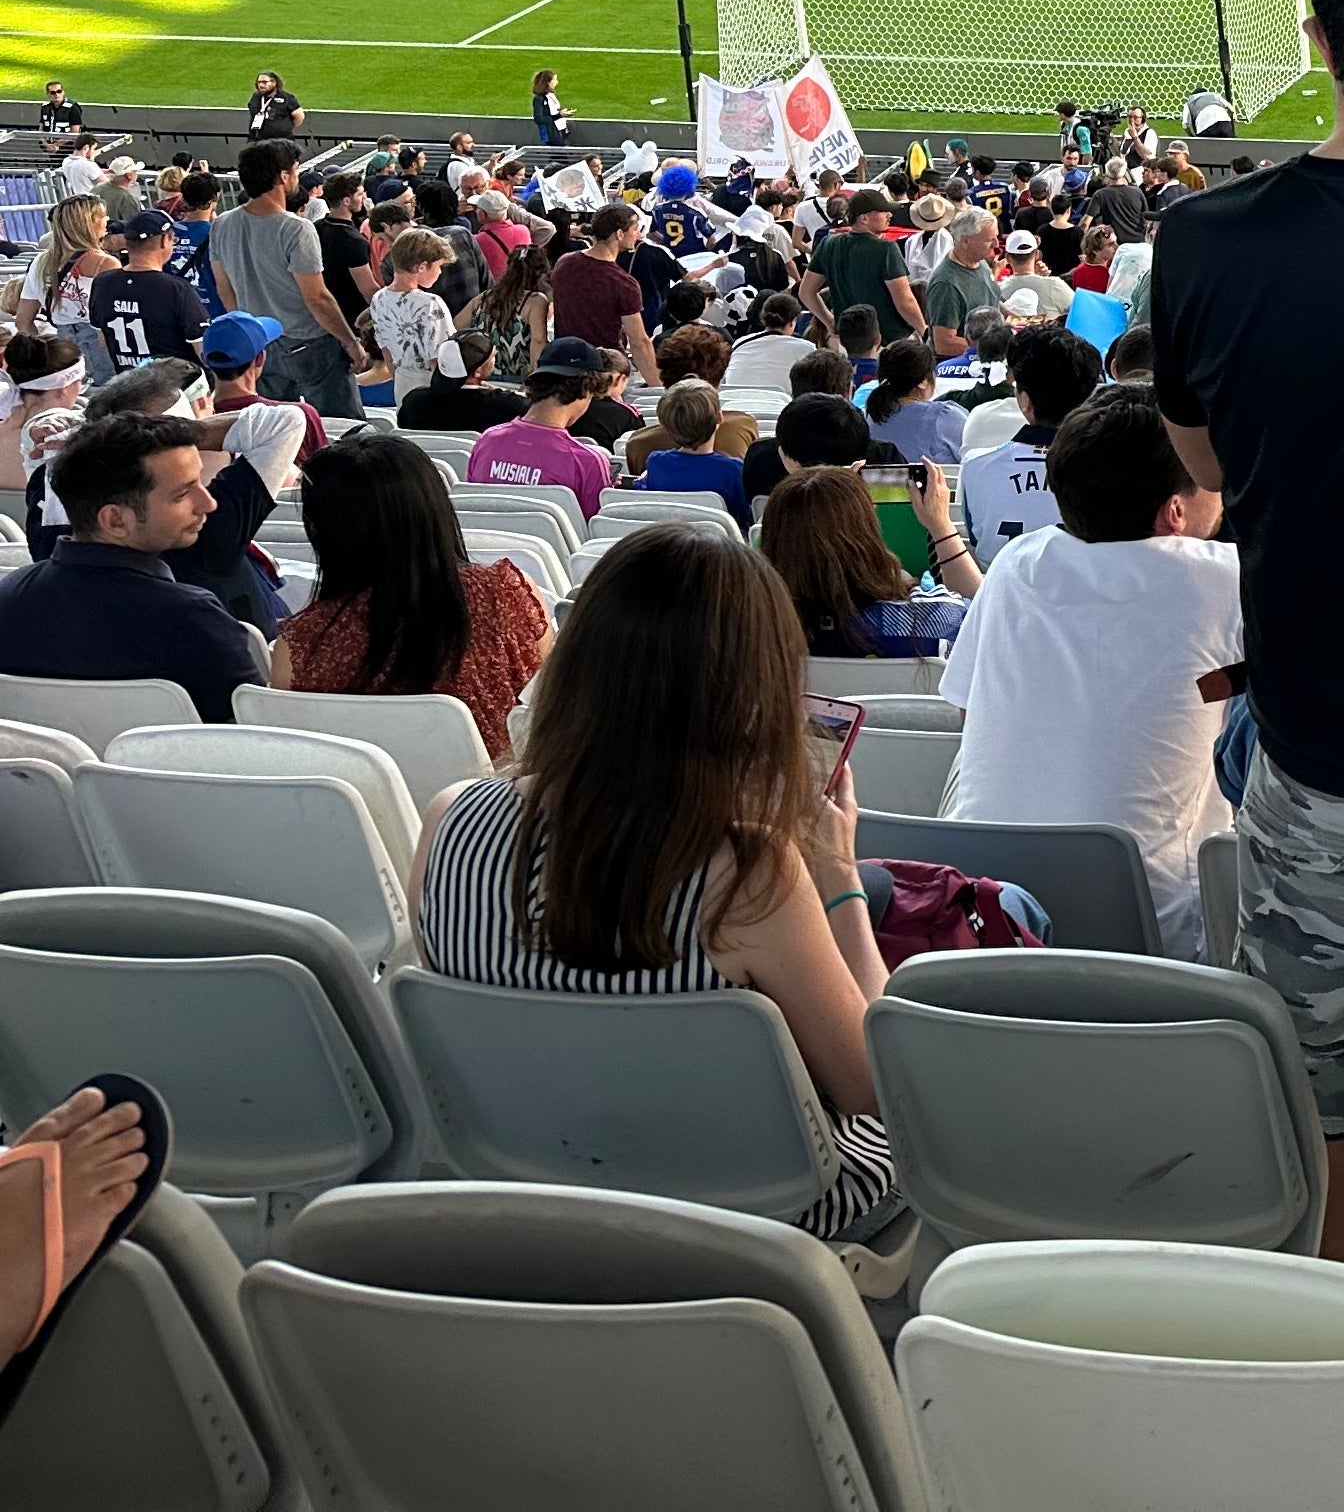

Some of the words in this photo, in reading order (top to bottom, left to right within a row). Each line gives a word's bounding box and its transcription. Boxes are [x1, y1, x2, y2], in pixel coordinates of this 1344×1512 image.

[666, 221, 685, 247] 9
[113, 300, 140, 314] SALA
[107, 316, 150, 355] 11
[936, 365, 969, 377] SUPER
[490, 460, 542, 486] MUSIALA
